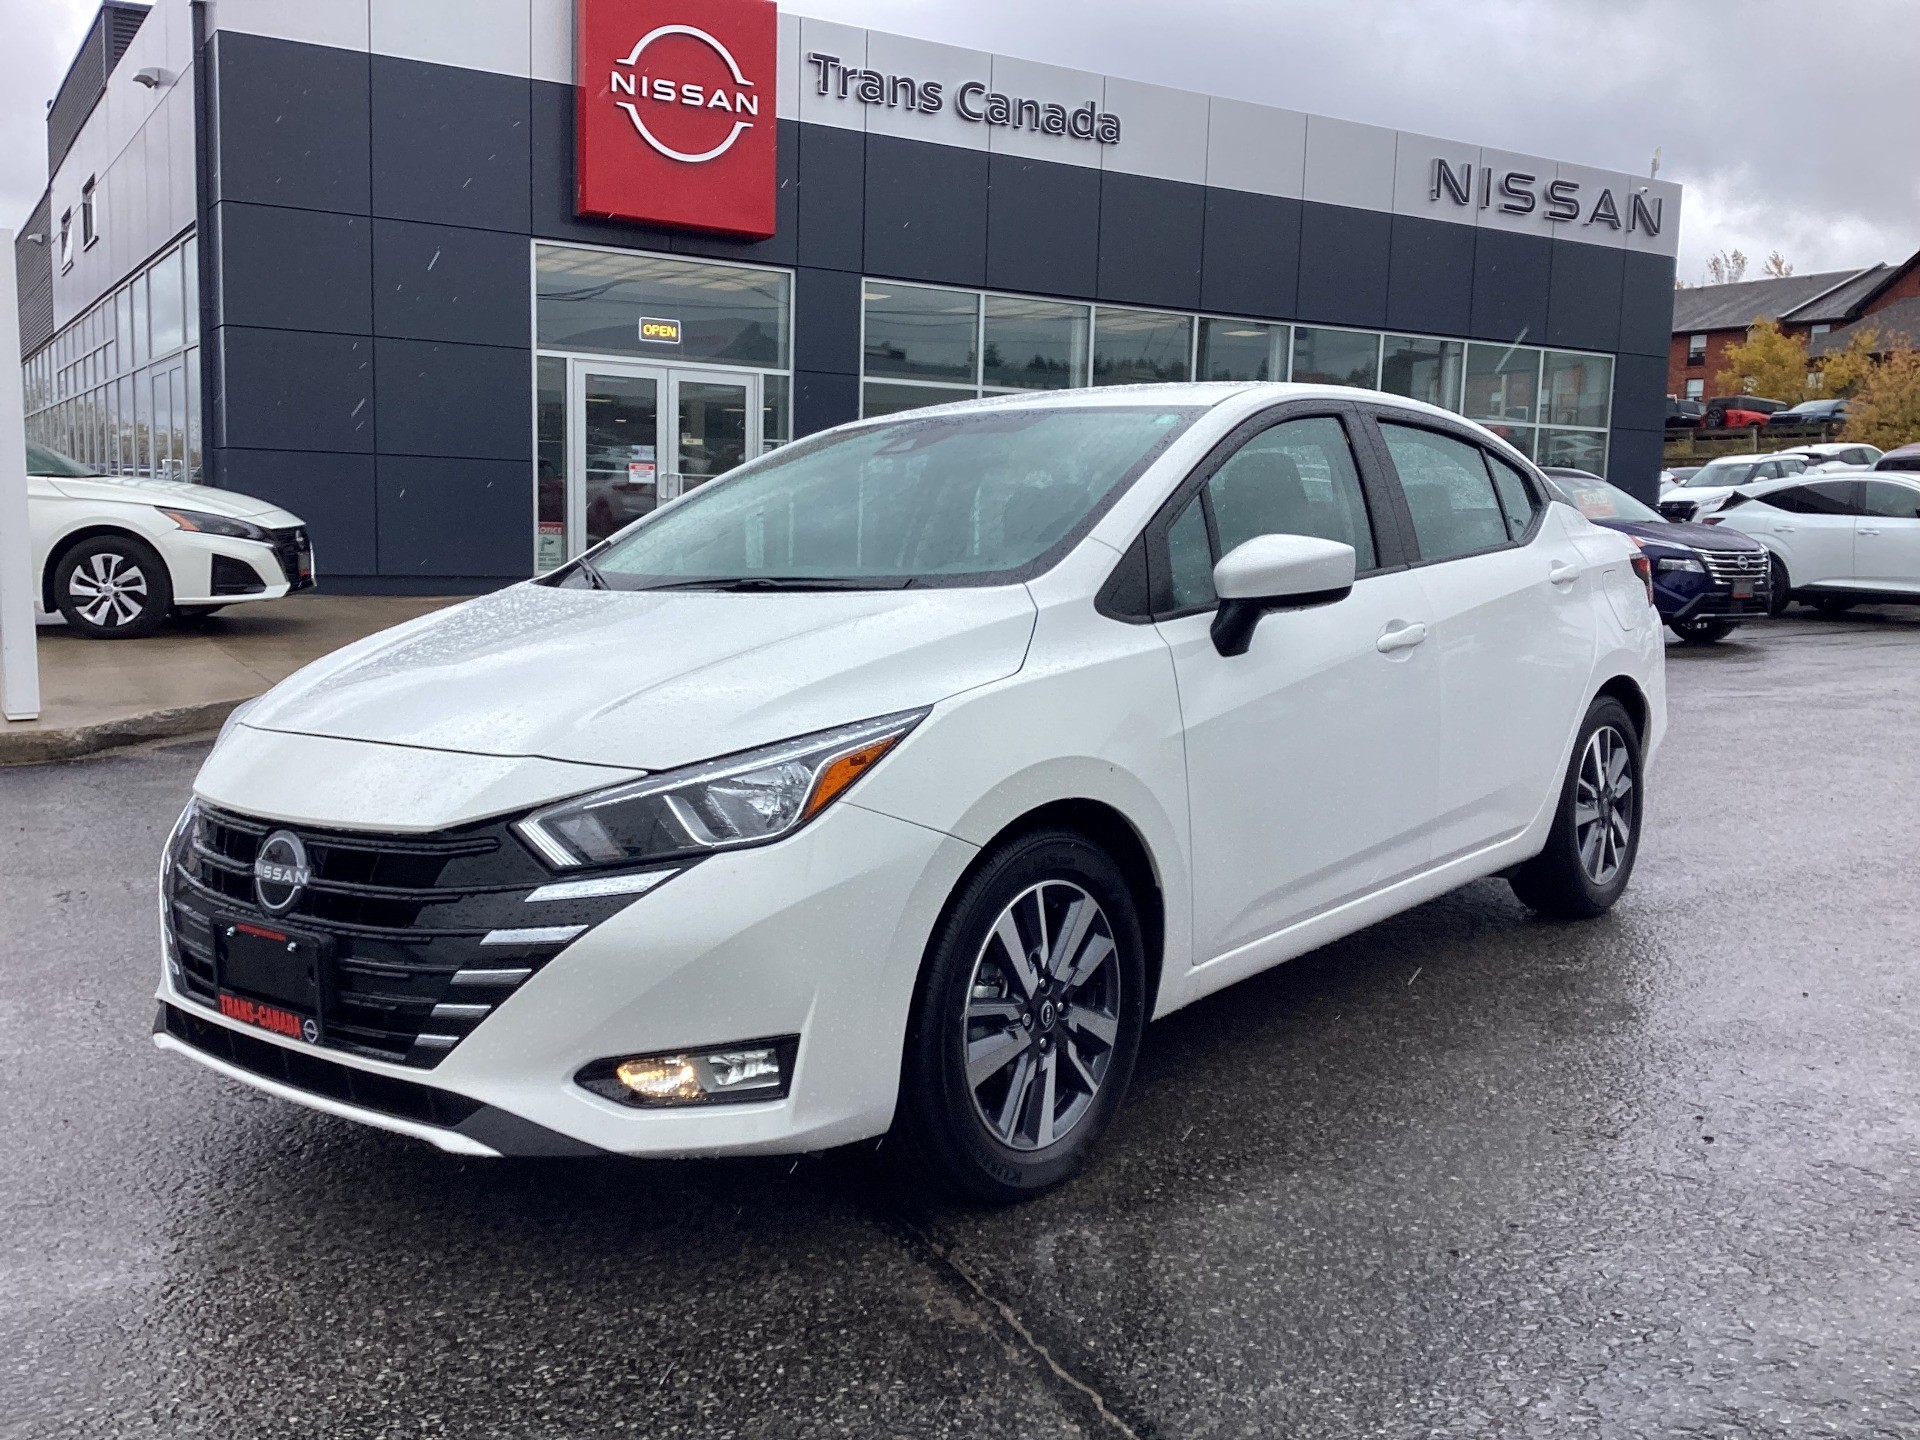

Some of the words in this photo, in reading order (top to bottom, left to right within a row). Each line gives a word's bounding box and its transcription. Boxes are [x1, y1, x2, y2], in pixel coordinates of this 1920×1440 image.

[610, 70, 759, 115] NISSAN
[808, 51, 943, 114] Trans
[955, 81, 1121, 144] Canada
[1430, 158, 1663, 236] NISSAN
[643, 324, 677, 338] OPEN
[538, 527, 562, 535] OTICE
[255, 861, 309, 885] NISSAN
[218, 993, 302, 1039] TRANS-CANADA
